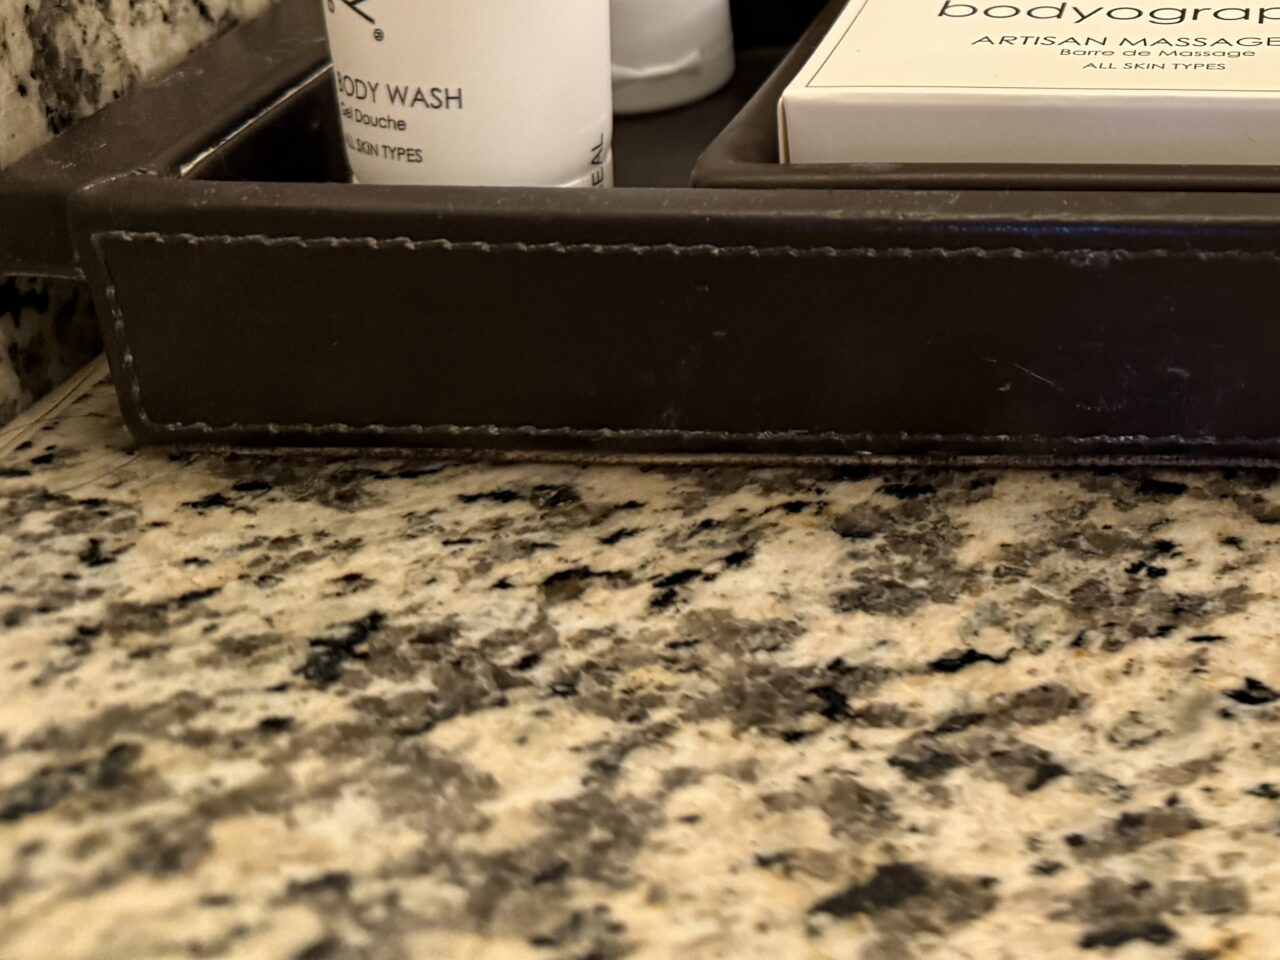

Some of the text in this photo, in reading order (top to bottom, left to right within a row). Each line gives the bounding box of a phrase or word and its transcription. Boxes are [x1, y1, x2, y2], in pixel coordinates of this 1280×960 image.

[971, 35, 1108, 46] ARTISAN
[1059, 48, 1256, 58] Barre de Massage
[1082, 62, 1226, 70] ALL SKIN TYPES
[386, 82, 464, 110] WASH
[354, 107, 407, 132] Douche
[355, 138, 380, 158] SKIN
[381, 144, 424, 164] TYPES
